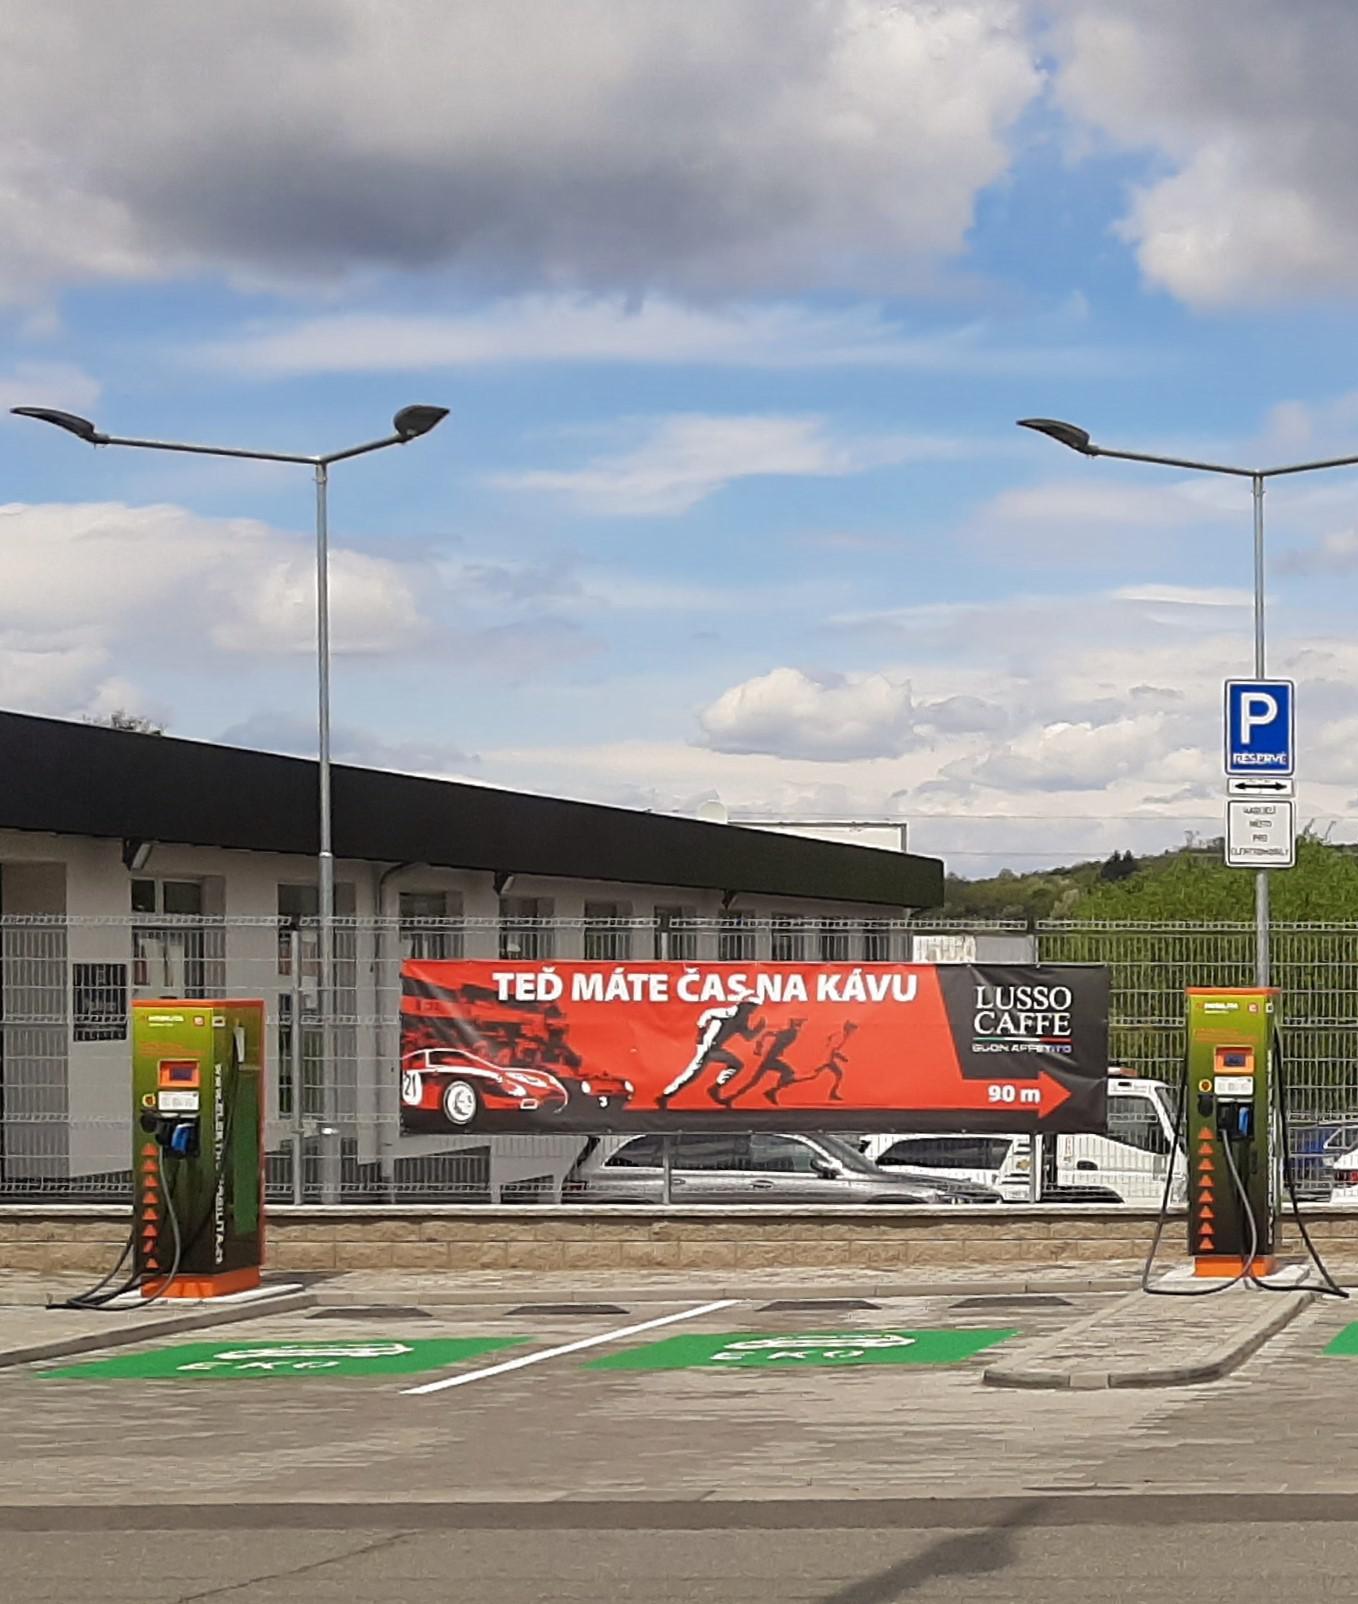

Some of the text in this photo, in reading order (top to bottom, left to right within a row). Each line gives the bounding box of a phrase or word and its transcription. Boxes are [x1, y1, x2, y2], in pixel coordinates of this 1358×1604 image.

[1241, 692, 1278, 744] P
[492, 966, 917, 1003] TEĎ MÁTE ČAS NA KÁVU
[976, 985, 1072, 1010] LUSSO
[973, 1010, 1072, 1036] CAFFE
[988, 1085, 1040, 1104] 90 m
